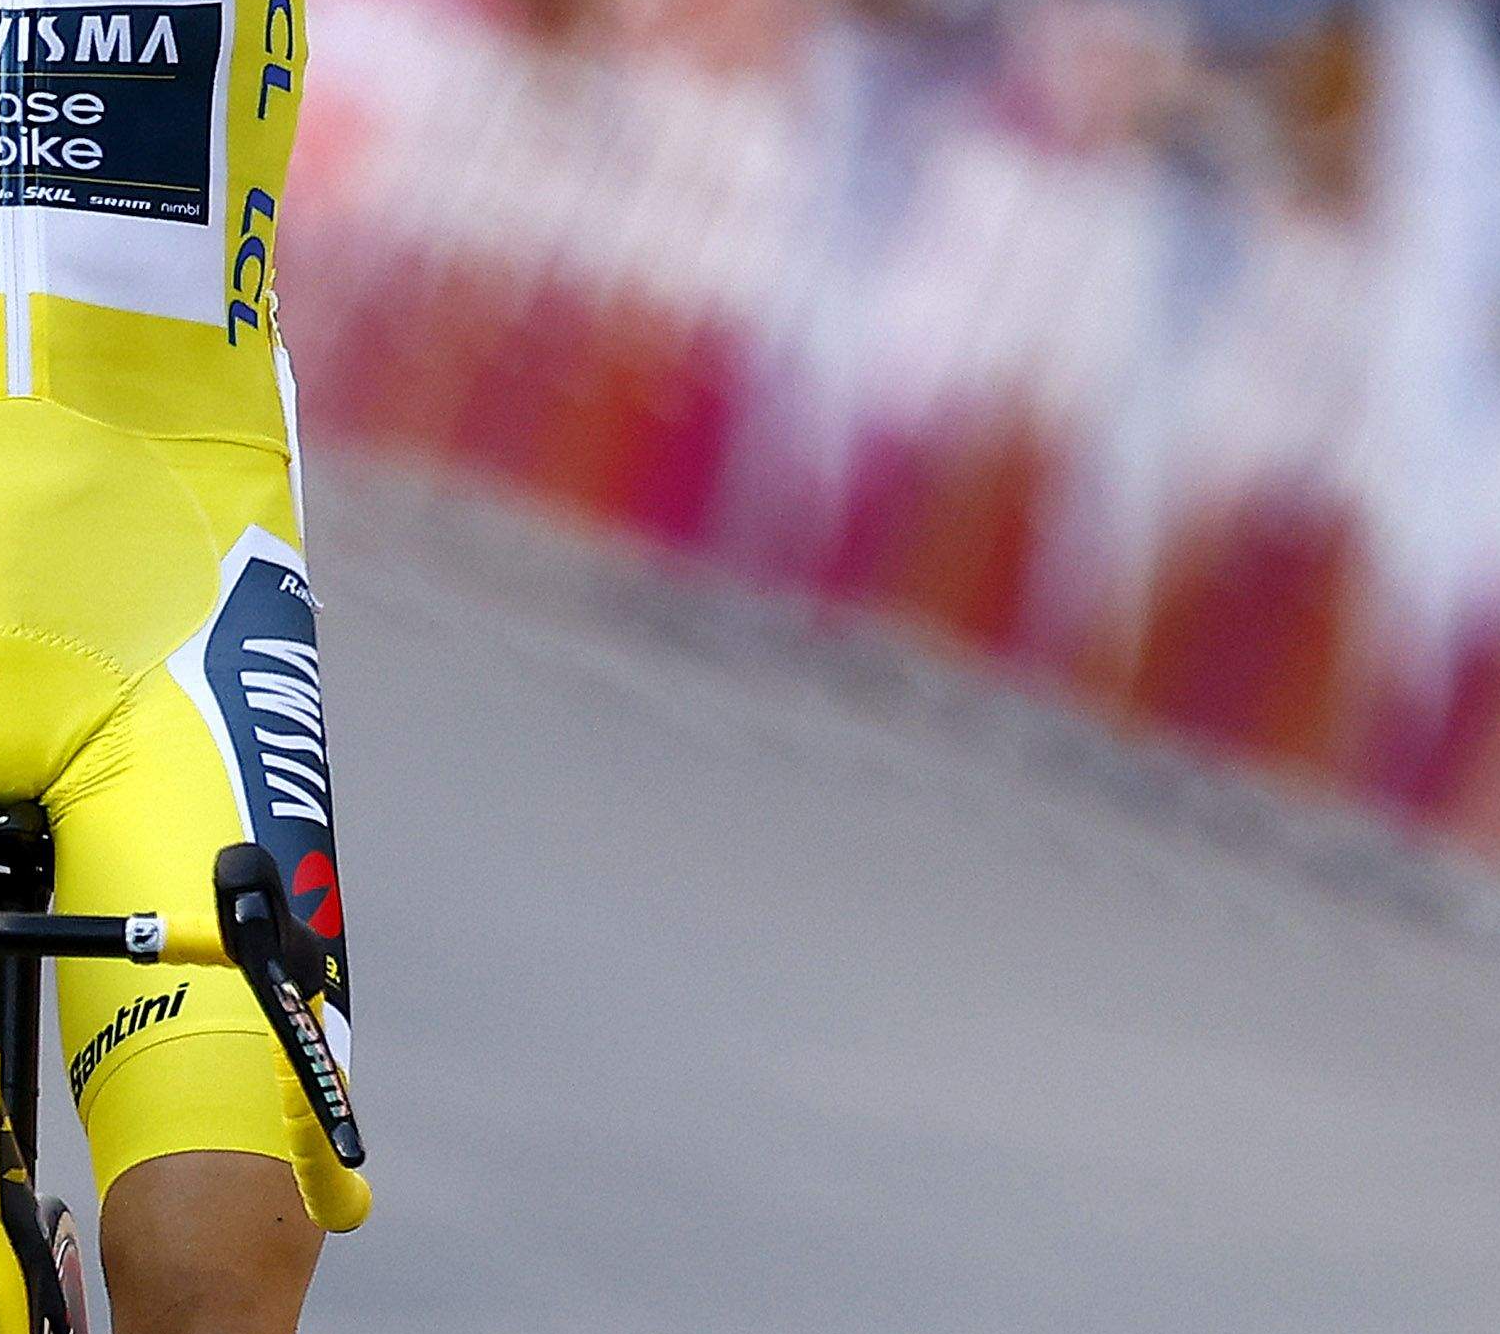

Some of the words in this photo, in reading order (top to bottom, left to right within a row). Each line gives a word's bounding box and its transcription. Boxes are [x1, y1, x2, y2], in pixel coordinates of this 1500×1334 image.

[23, 185, 76, 203] SKIL
[160, 202, 200, 216] nimbl
[228, 187, 275, 347] LCL
[239, 638, 329, 827] VISMA
